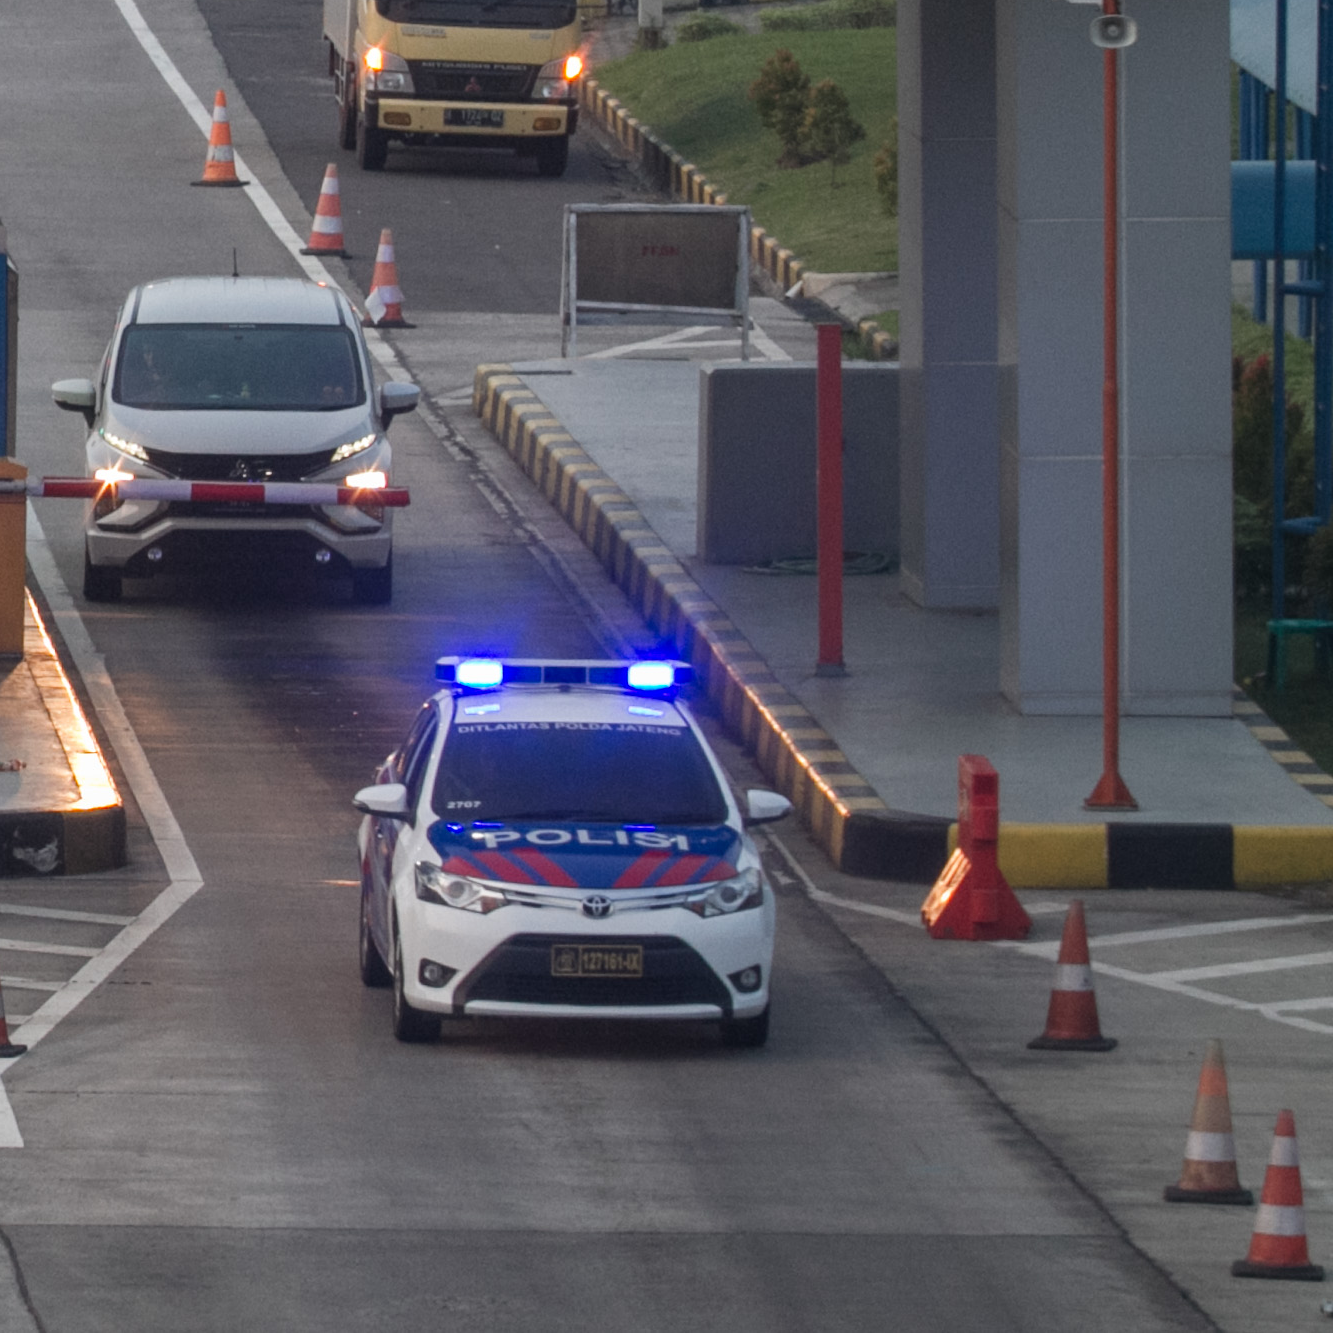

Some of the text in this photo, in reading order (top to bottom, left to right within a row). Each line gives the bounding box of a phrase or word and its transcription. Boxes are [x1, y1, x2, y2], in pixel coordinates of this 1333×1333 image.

[457, 721, 681, 736] DITLANTAS POLDA JATENG
[446, 800, 482, 810] 2707
[484, 828, 689, 852] POLISI
